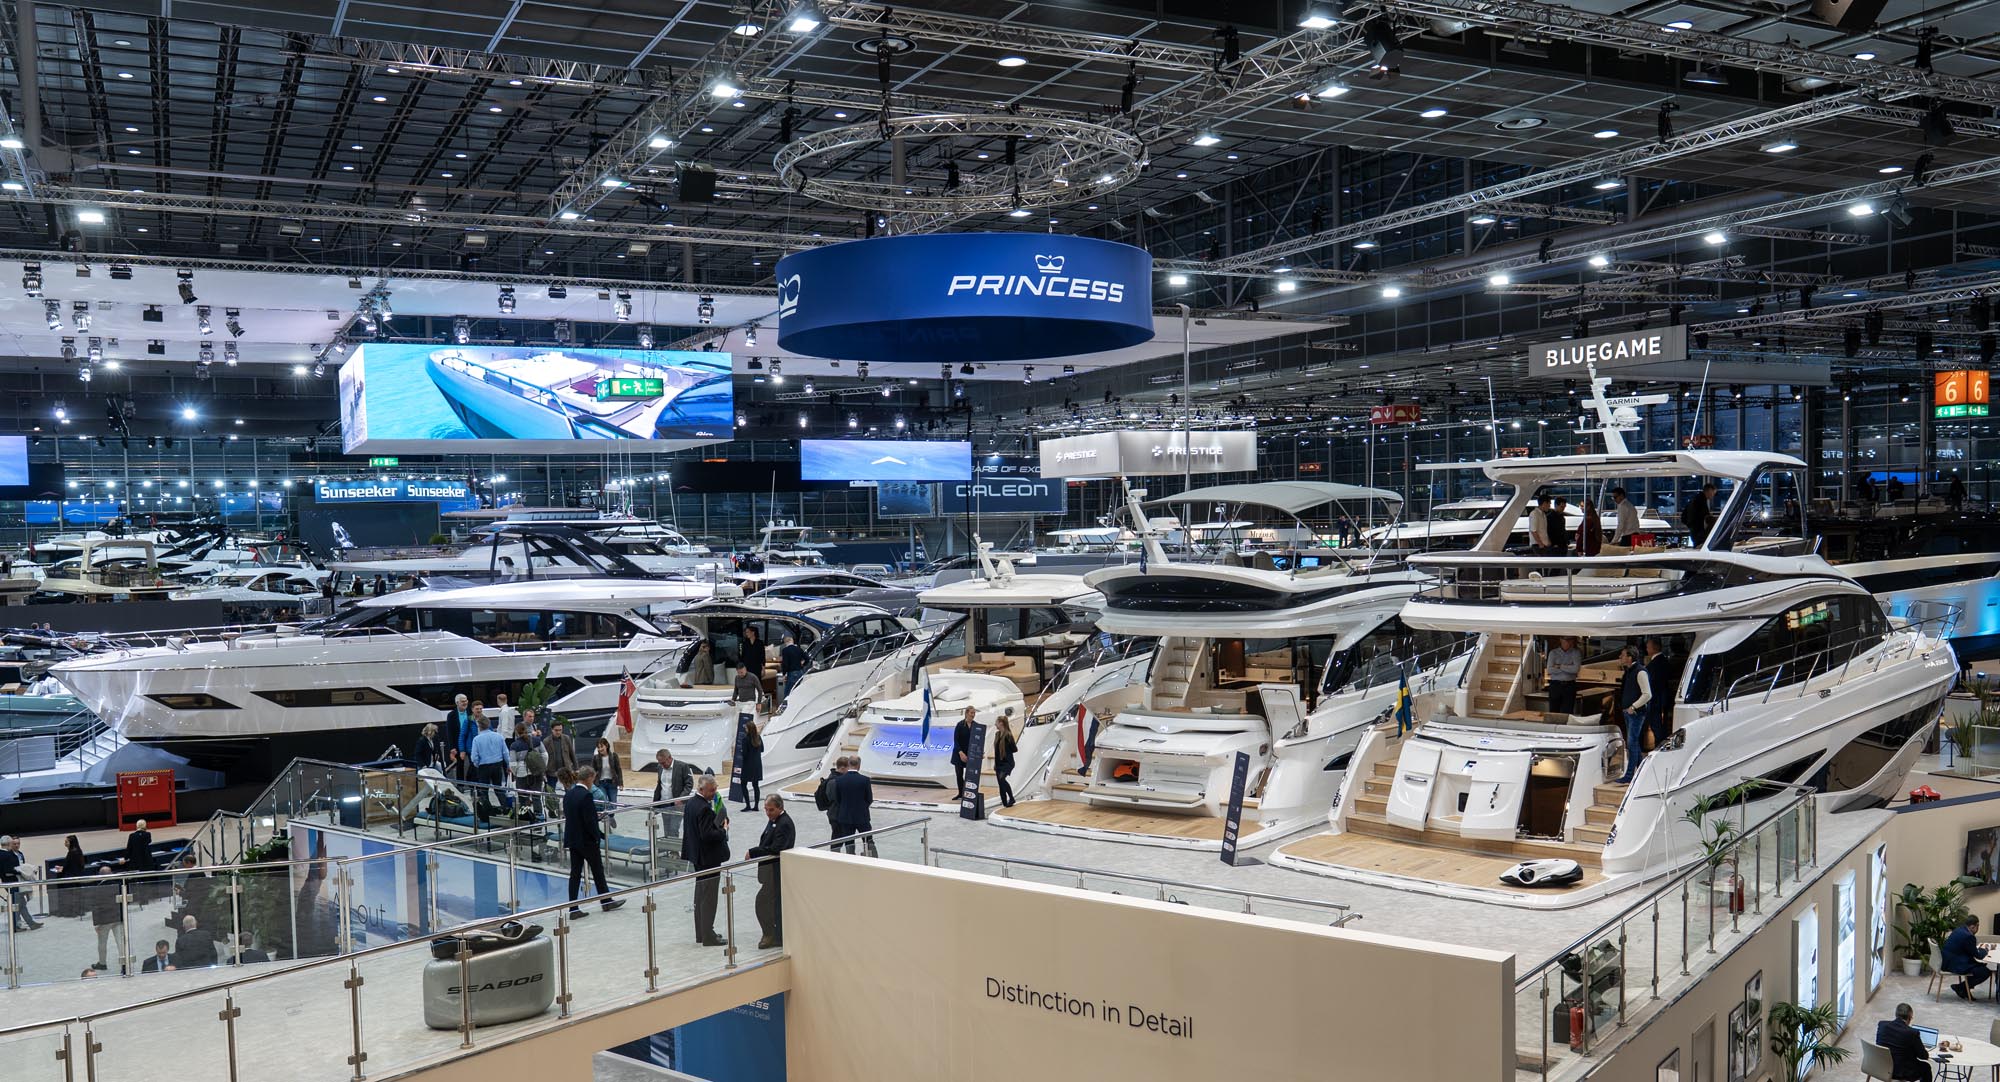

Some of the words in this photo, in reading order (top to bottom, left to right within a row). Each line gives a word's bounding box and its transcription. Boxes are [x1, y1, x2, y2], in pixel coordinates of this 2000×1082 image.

[947, 275, 1125, 303] PRINCESS
[1545, 336, 1661, 367] BLUEGAME
[1945, 381, 1957, 402] 6
[1974, 380, 1983, 401] 6
[1606, 397, 1640, 406] GARMIN
[1063, 449, 1097, 460] PRESTIGE
[1167, 446, 1223, 455] PRESTIGE
[1000, 465, 1017, 473] OF
[320, 485, 398, 499] Sunseeker
[407, 484, 466, 498] Sunseeker
[956, 484, 1048, 497] GALEON
[664, 723, 688, 733] V50
[896, 750, 920, 759] V55
[447, 973, 544, 995] SEABOB
[986, 976, 1095, 1019] Distinction
[1102, 999, 1121, 1024] in
[1128, 1005, 1193, 1039] Detail
